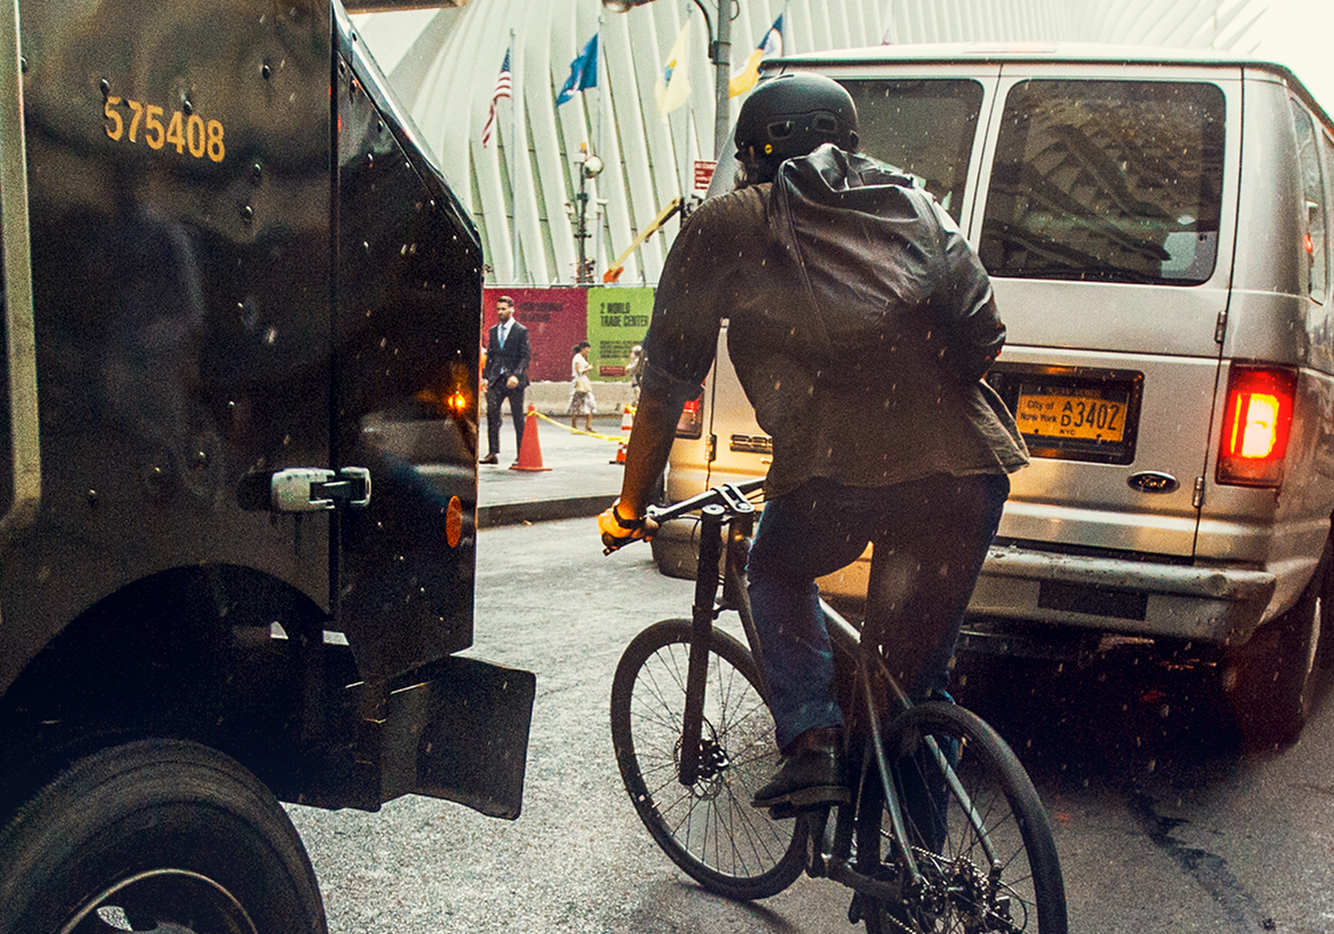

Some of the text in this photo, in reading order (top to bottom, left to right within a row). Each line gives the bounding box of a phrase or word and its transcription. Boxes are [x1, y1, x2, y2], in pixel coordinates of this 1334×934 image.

[104, 95, 226, 163] 575408
[600, 302, 630, 314] 2 WORLD
[600, 315, 649, 327] TRADE CENTER
[1027, 400, 1054, 411] City of
[1020, 413, 1057, 423] New York
